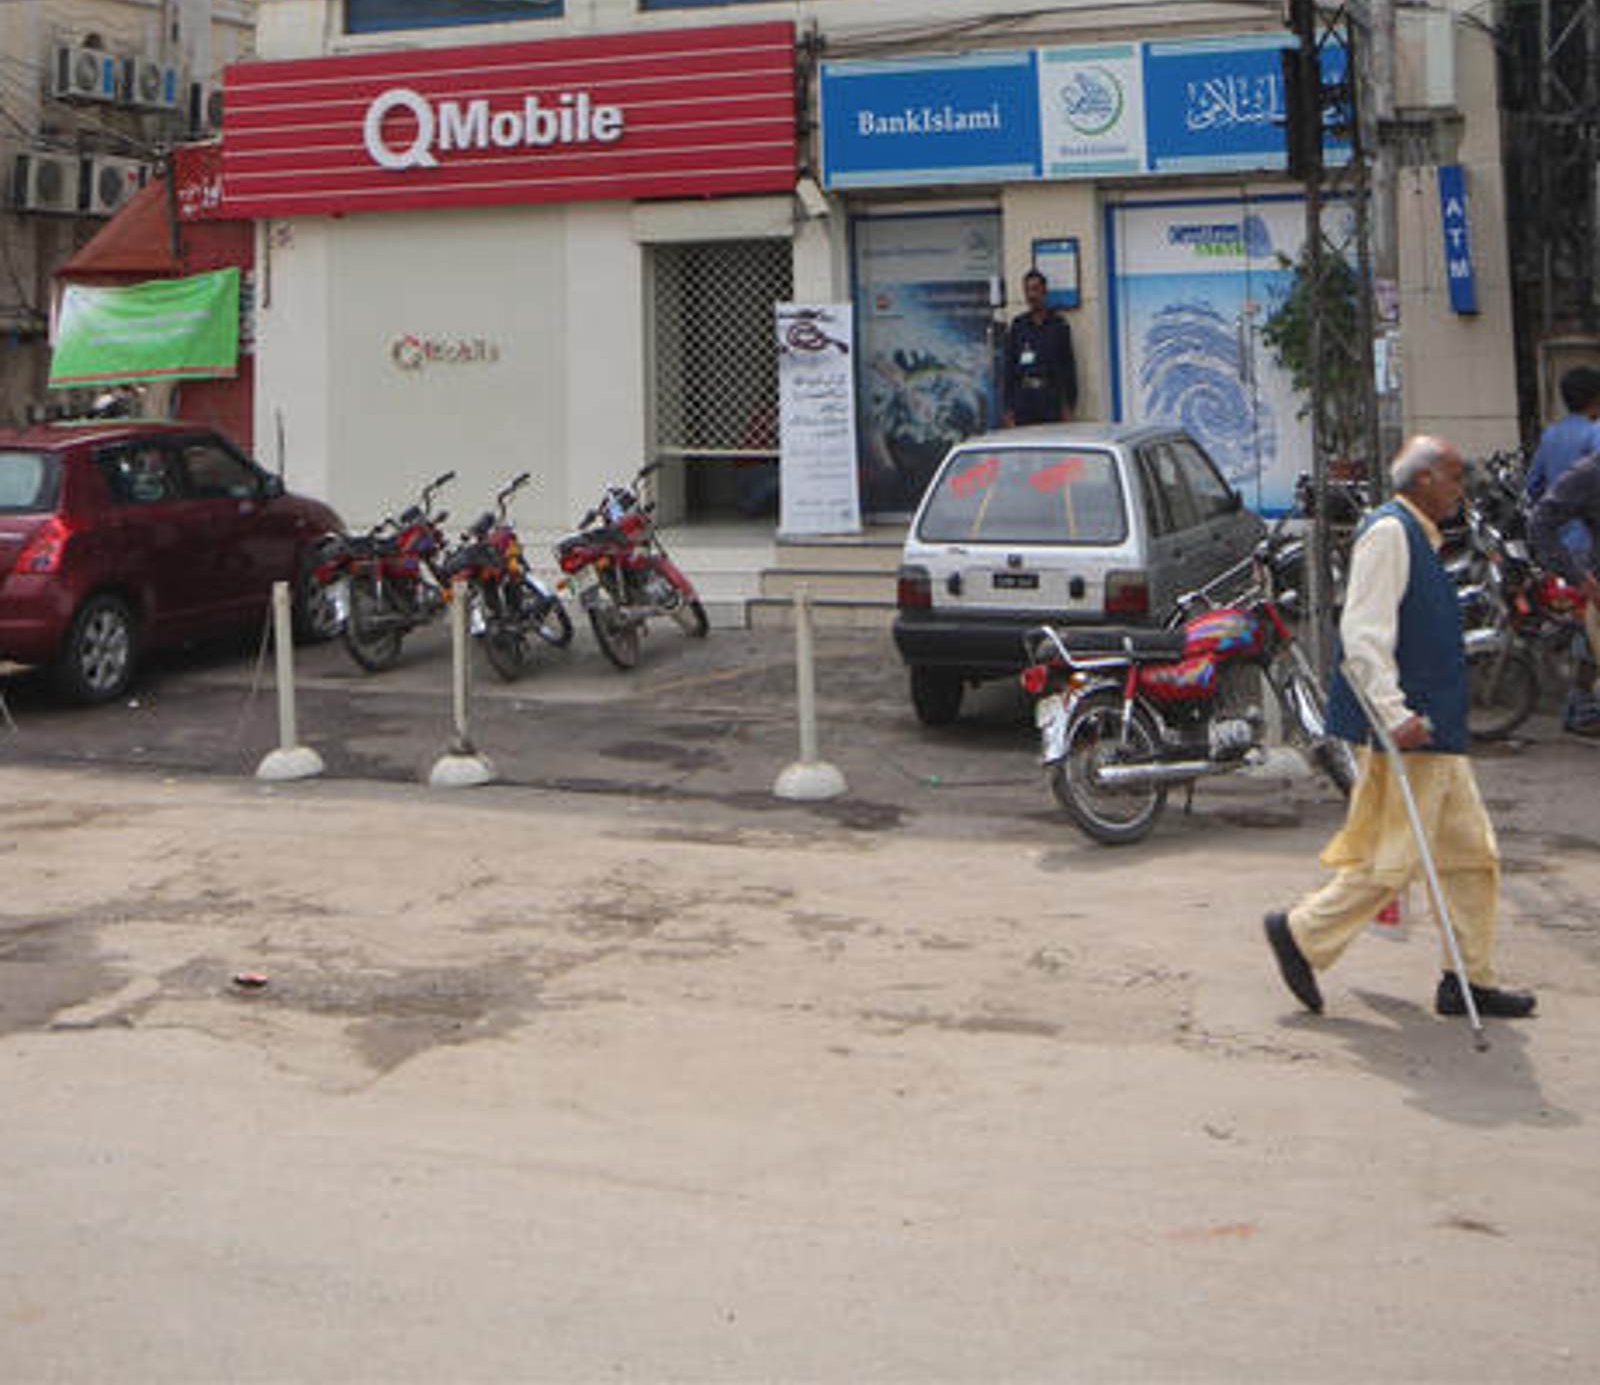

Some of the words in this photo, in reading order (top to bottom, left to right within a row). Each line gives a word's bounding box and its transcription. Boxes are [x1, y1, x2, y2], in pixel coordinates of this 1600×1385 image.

[363, 88, 624, 171] QMobile
[857, 99, 1001, 136] BankIslami
[1446, 196, 1471, 279] ATM
